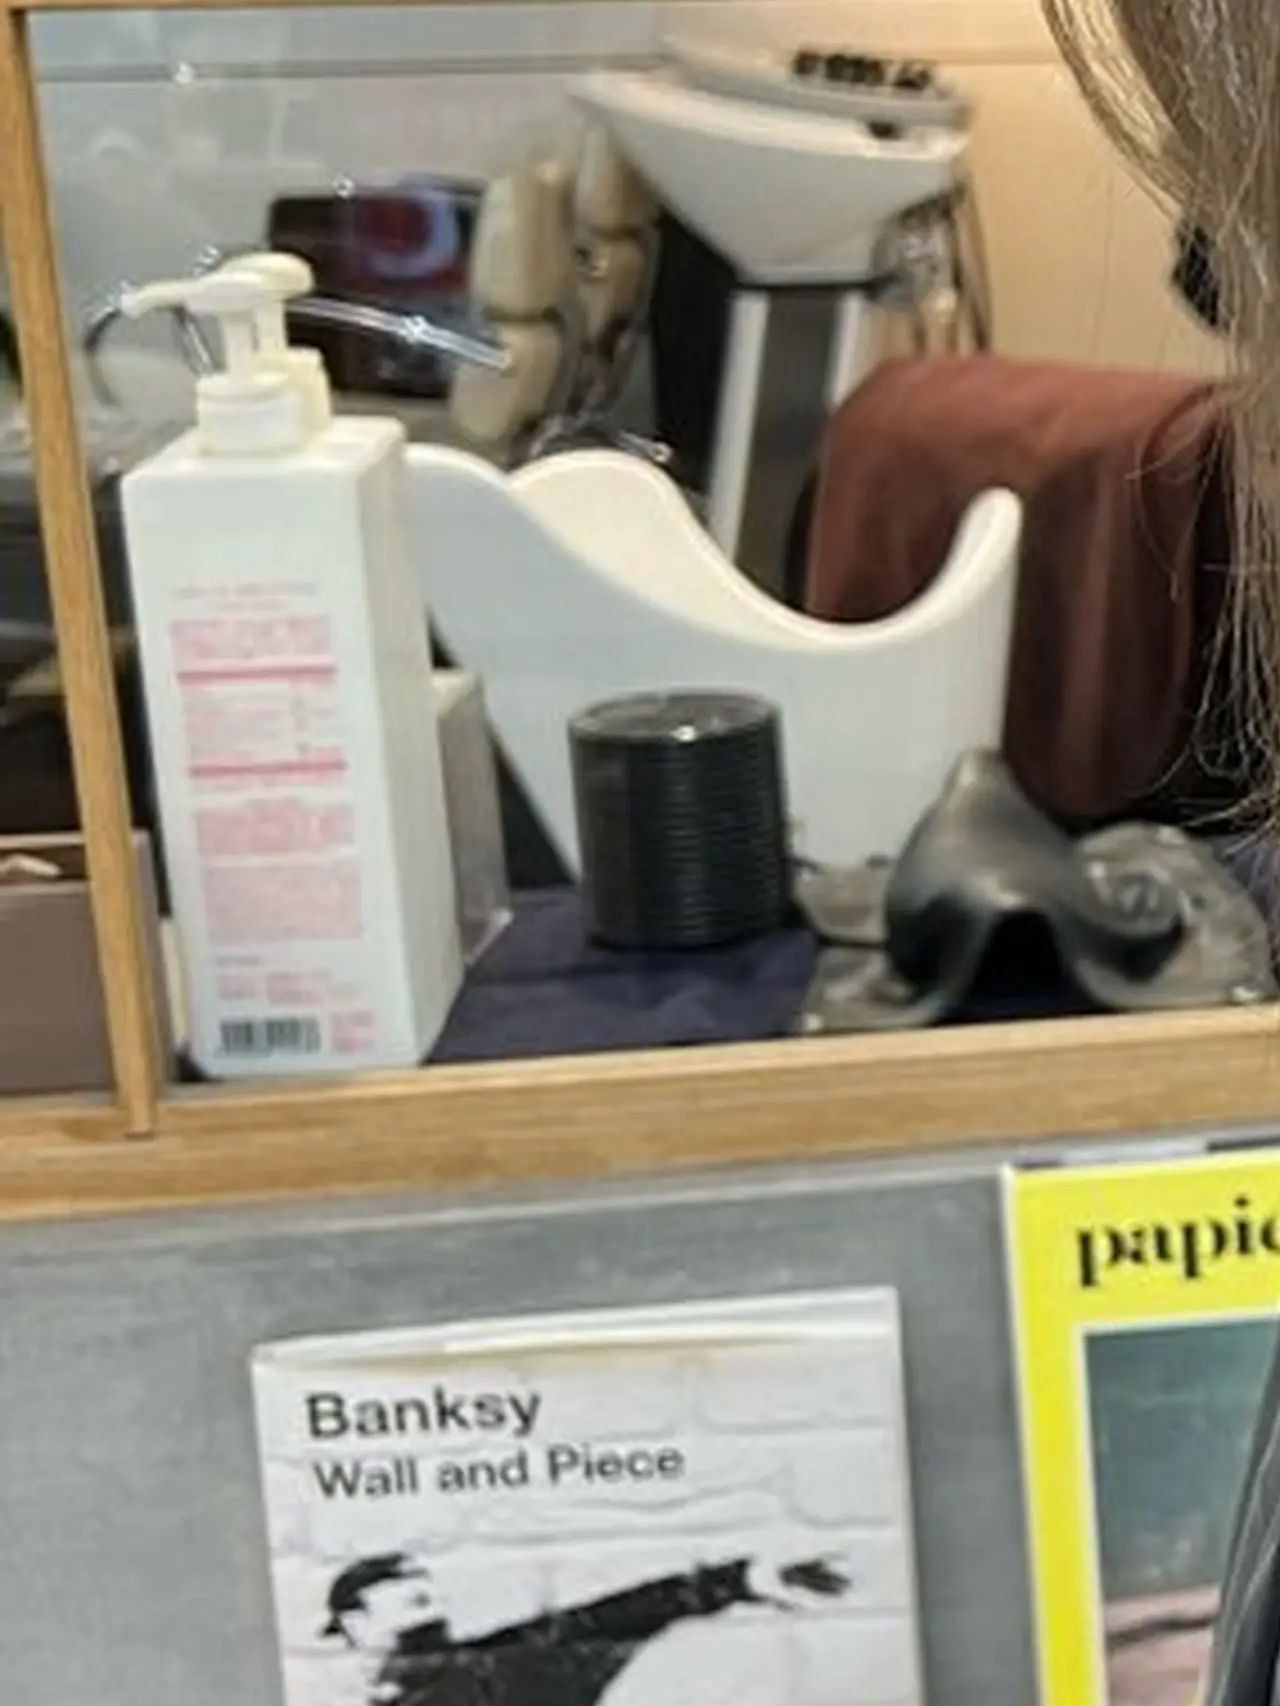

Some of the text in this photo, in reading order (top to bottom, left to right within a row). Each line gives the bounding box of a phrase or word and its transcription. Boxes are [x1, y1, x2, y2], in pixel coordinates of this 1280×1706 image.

[307, 1384, 542, 1438] Banksy
[312, 1442, 686, 1501] Wall and Piece
